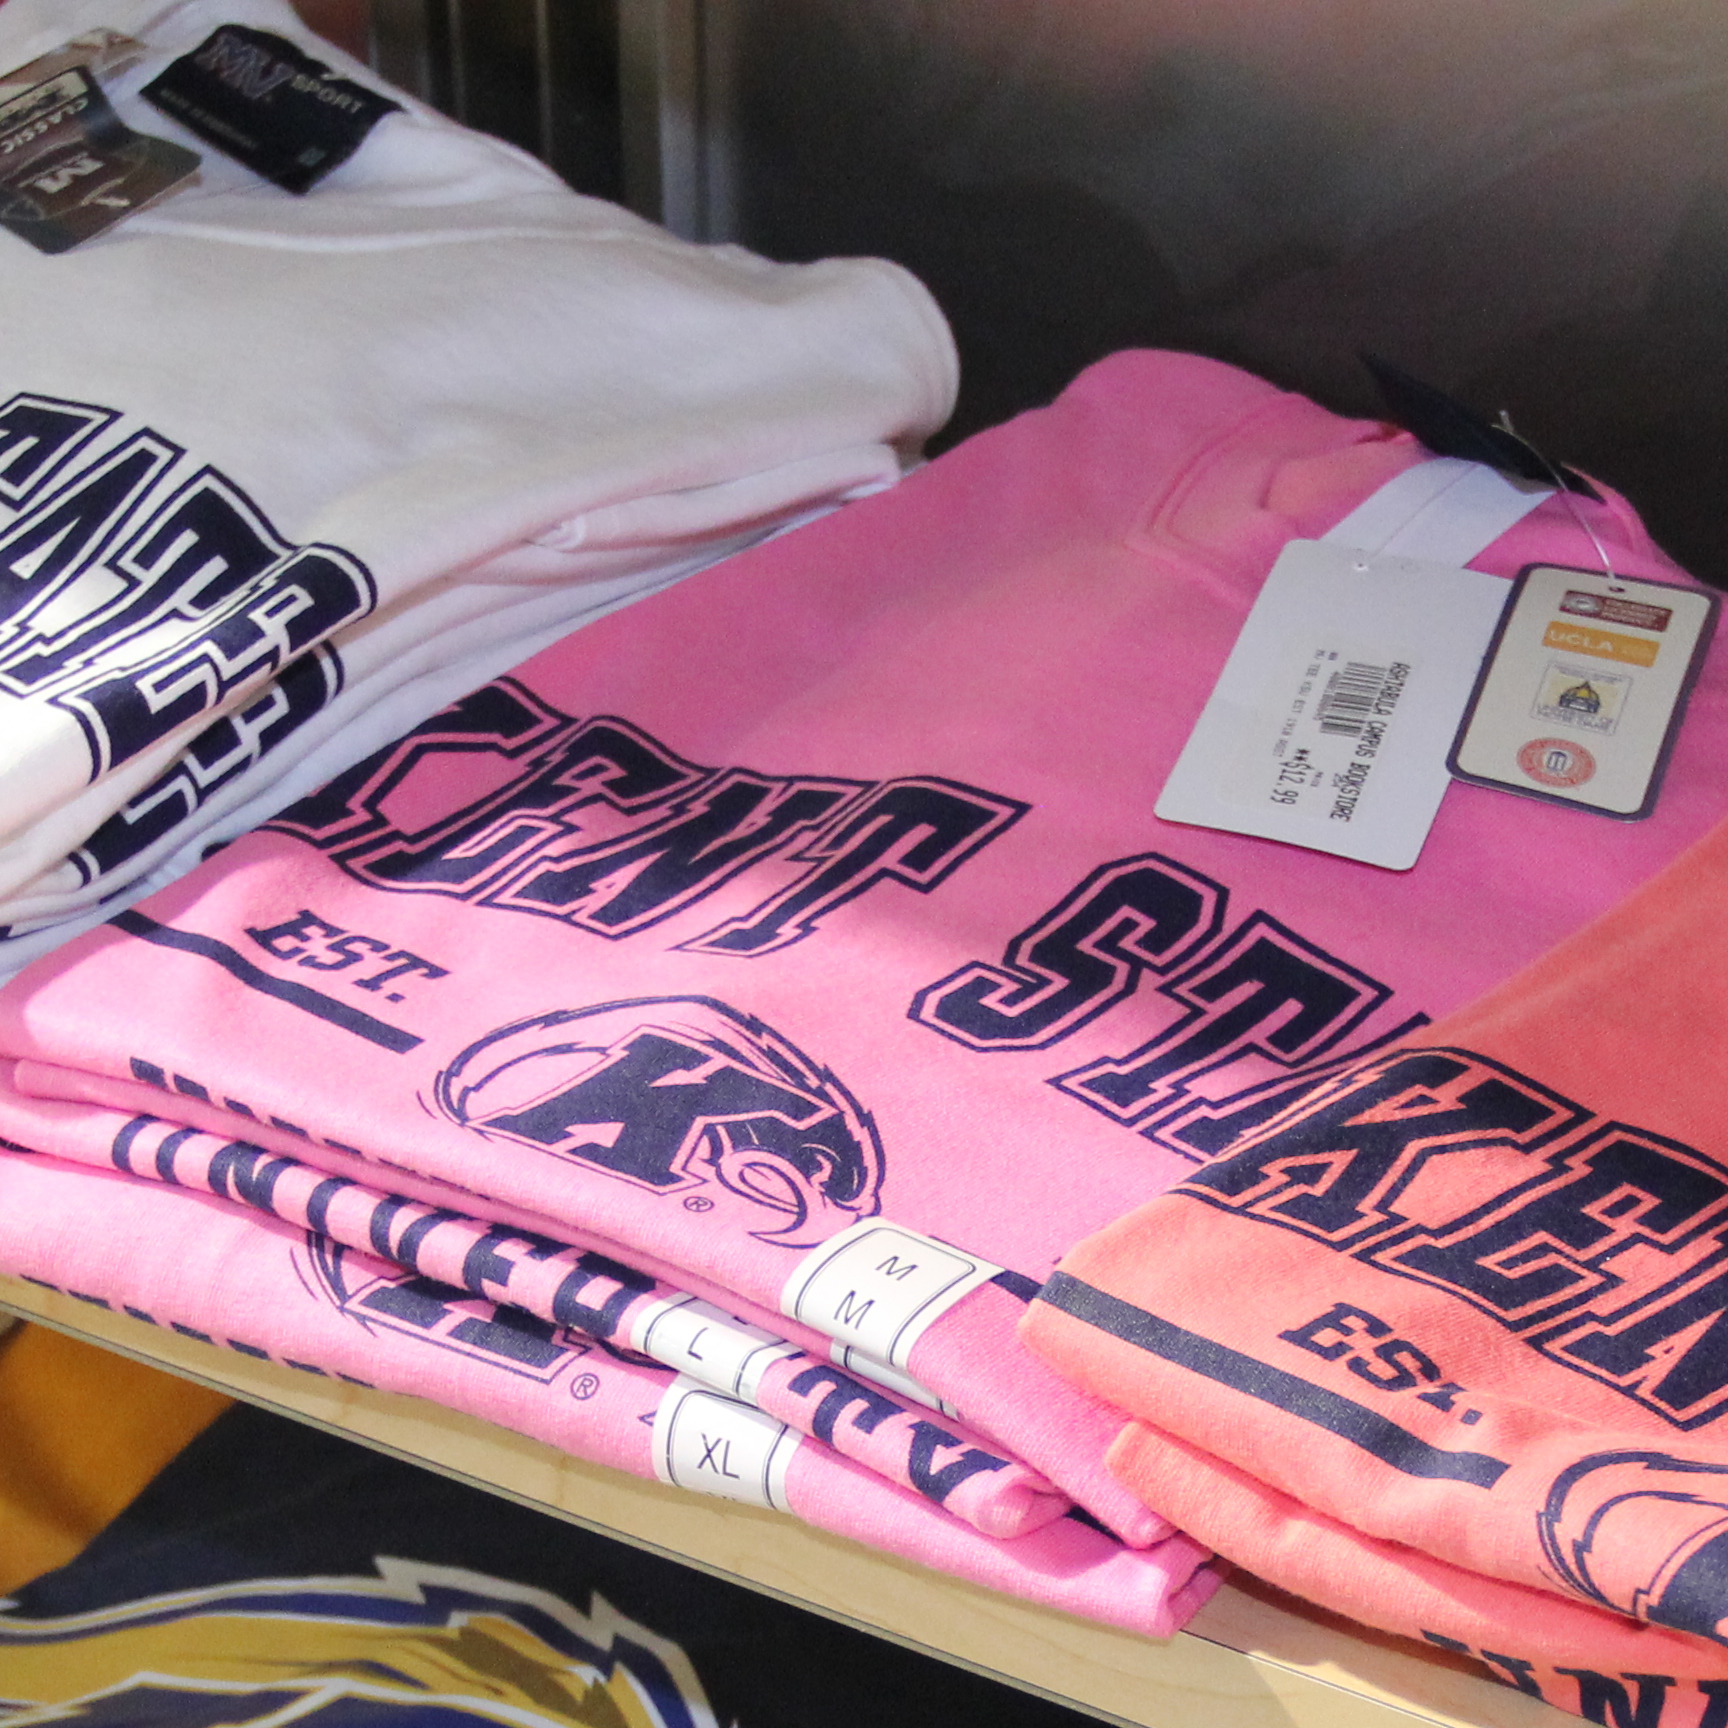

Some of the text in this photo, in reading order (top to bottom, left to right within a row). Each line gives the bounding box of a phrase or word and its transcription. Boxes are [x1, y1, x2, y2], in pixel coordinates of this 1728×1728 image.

[290, 75, 364, 113] SPORT
[0, 94, 90, 155] CLASSIC
[1549, 627, 1615, 652] UCLA
[1372, 661, 1410, 717] ASHTABULA
[1354, 719, 1388, 760] CAMPUS
[1329, 762, 1371, 823] BOOKSTORE
[245, 909, 450, 1003] EST.
[875, 1255, 918, 1282] M
[832, 1290, 876, 1330] M
[686, 1327, 710, 1362] L
[696, 1432, 741, 1480] XL
